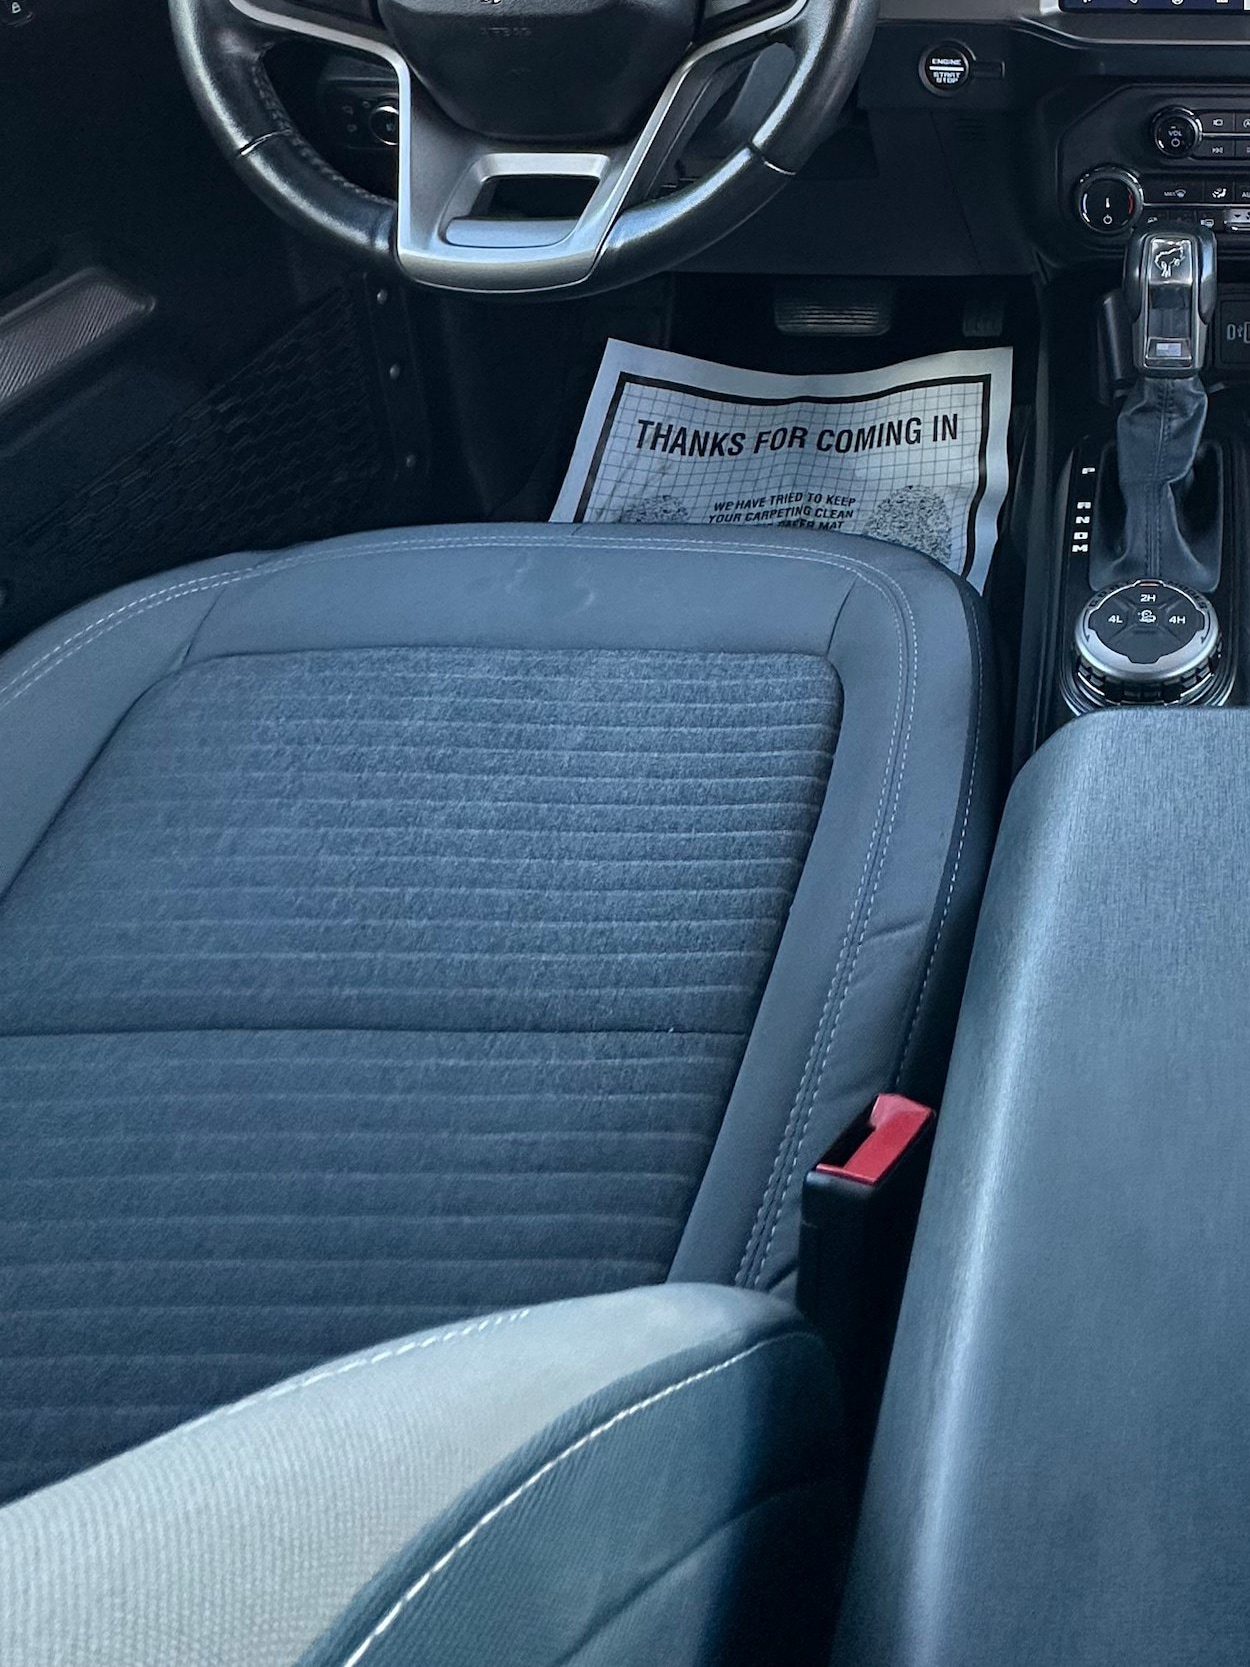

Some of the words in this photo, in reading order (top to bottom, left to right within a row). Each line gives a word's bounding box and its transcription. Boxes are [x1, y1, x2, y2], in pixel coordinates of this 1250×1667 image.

[636, 418, 746, 458] THANKS
[753, 426, 807, 455] FOR
[816, 416, 922, 454] COMING
[932, 413, 959, 442] IN
[714, 501, 735, 512] WE
[735, 497, 766, 510] HAVE
[770, 492, 803, 506] TRIED
[807, 492, 822, 504] TO
[826, 495, 856, 507] KEEP
[709, 512, 744, 524] YOUR
[745, 505, 812, 522] CARPETING
[814, 507, 853, 519] CLEAN
[818, 520, 844, 531] MAT
[1074, 532, 1088, 540] D
[1072, 544, 1088, 552] M
[1140, 594, 1156, 602] 2H
[1108, 615, 1123, 623] 4L
[1169, 616, 1185, 624] 4H
